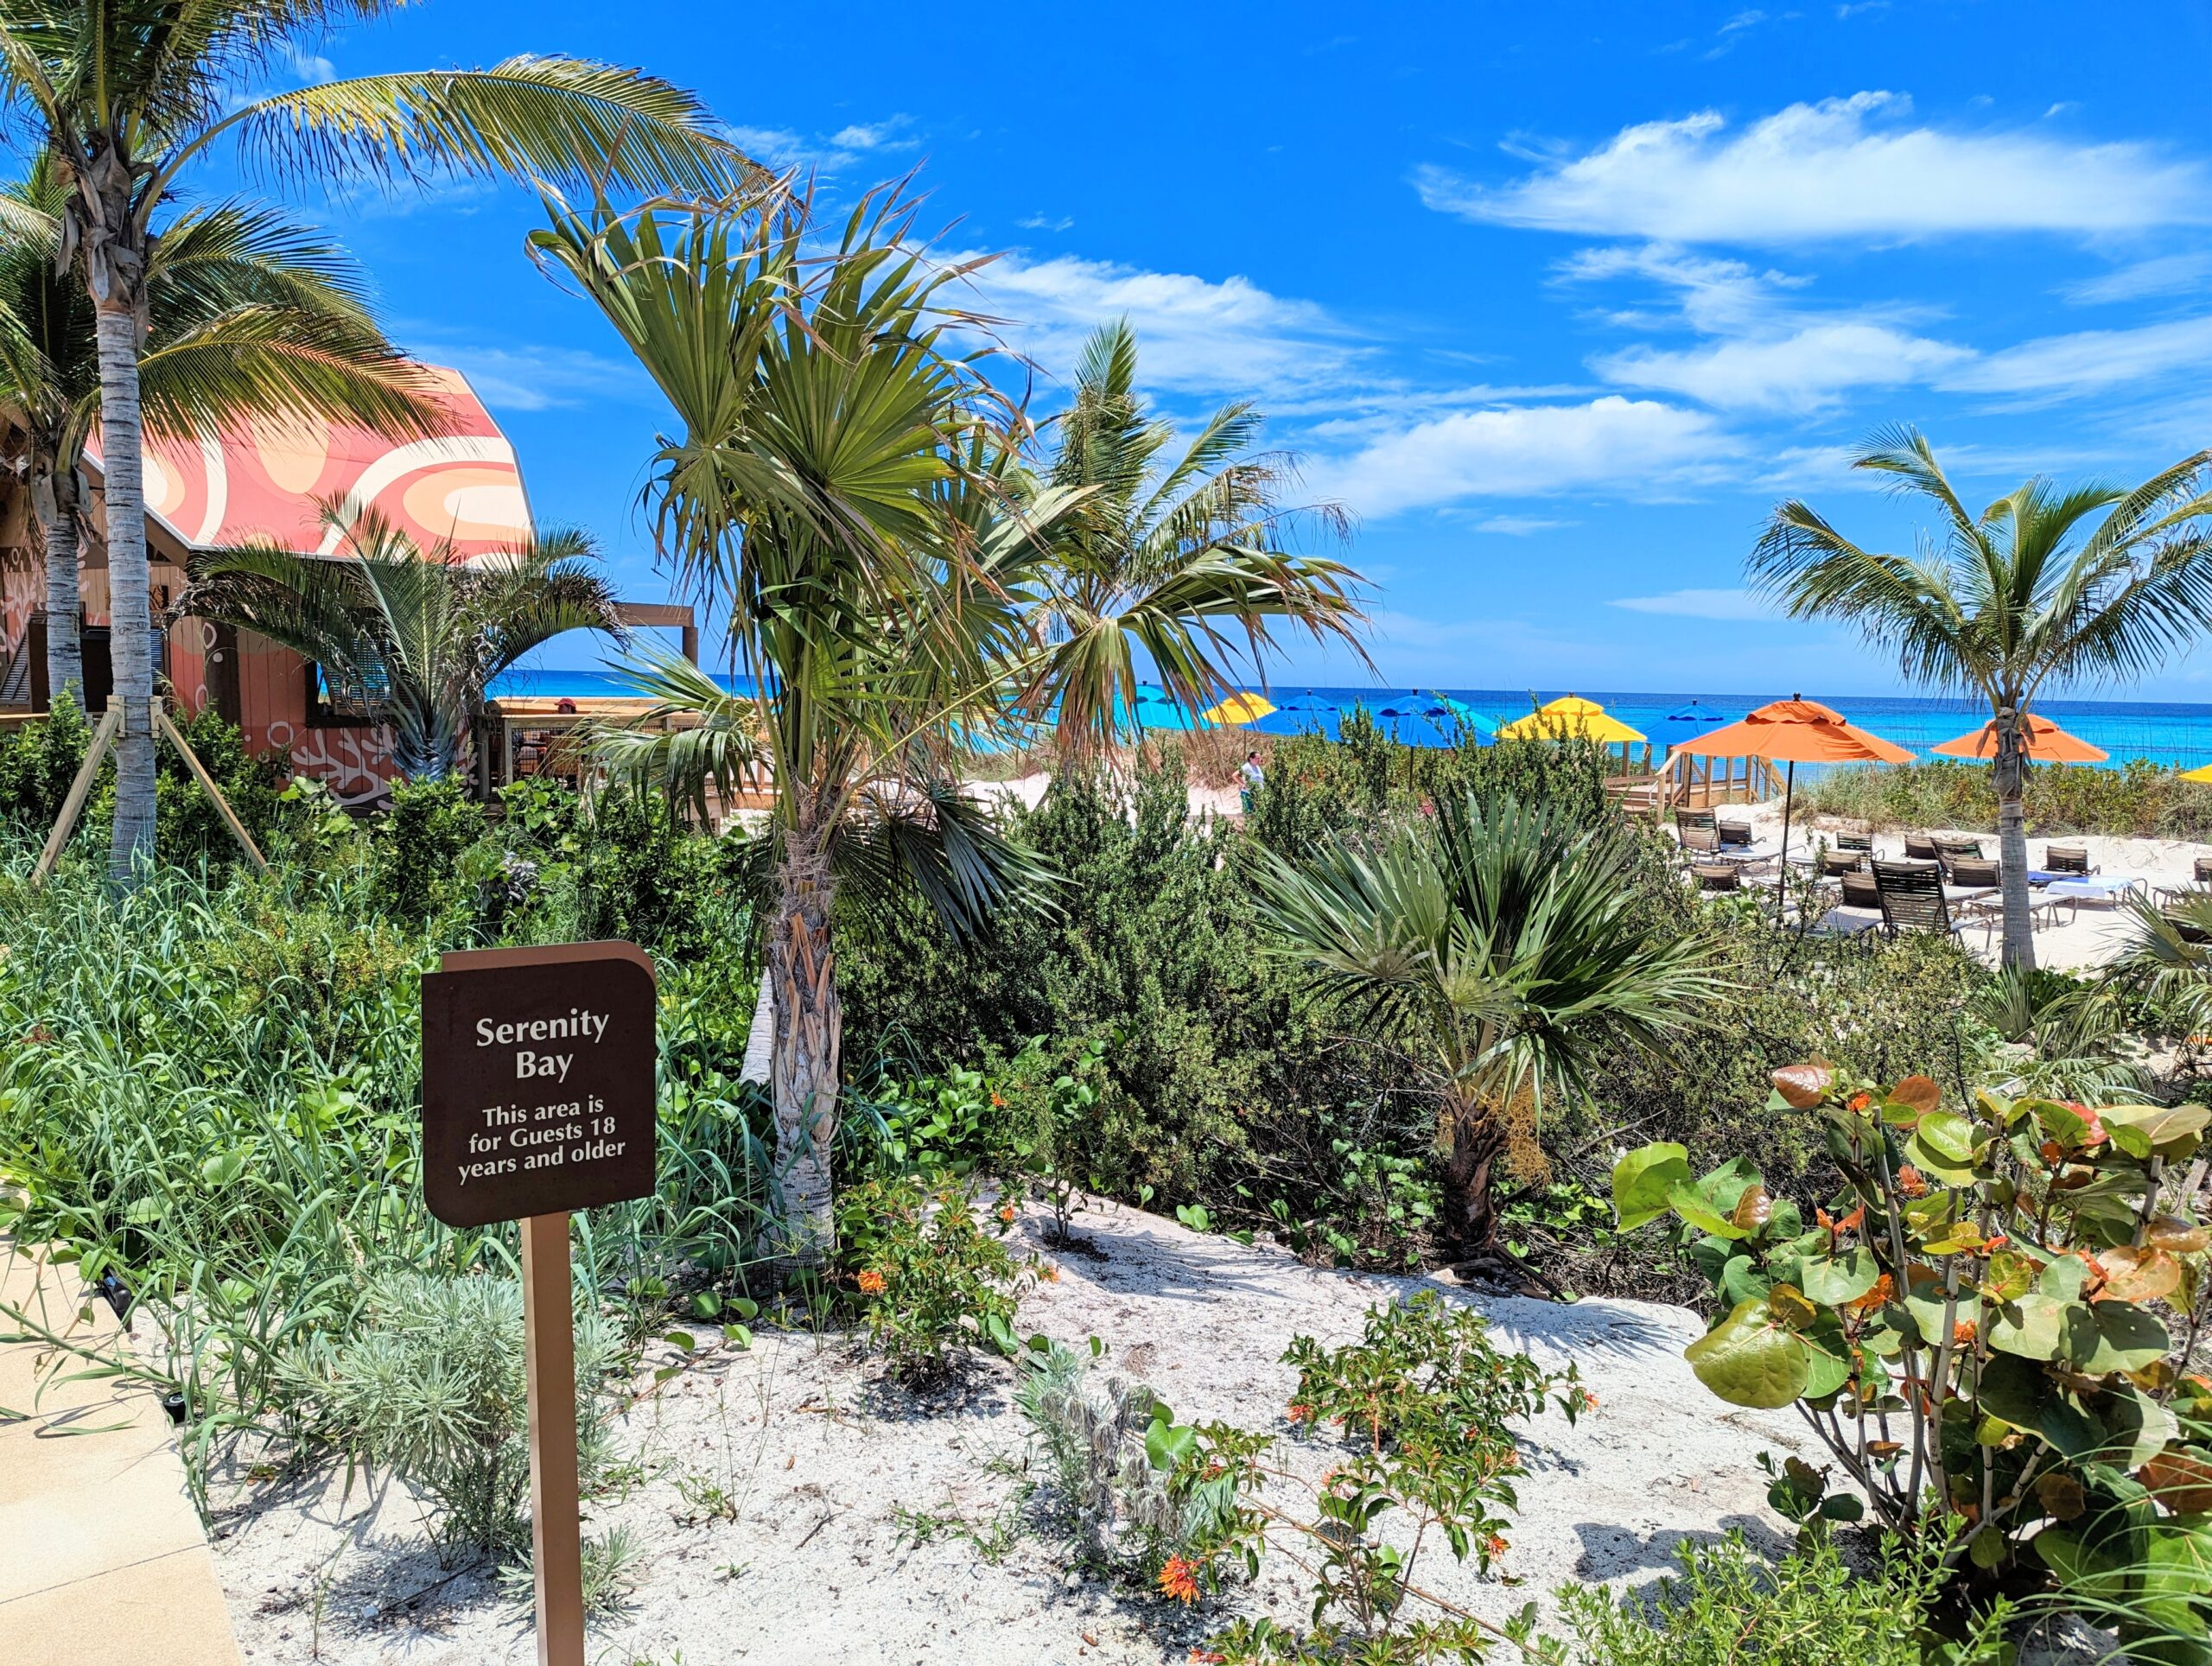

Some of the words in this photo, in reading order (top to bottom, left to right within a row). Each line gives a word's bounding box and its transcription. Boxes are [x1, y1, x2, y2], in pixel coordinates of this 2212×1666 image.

[476, 1008, 609, 1046] Serenity
[517, 1051, 574, 1084] Bay
[482, 1103, 527, 1127] This
[534, 1102, 581, 1121] area
[588, 1094, 604, 1113] is
[468, 1133, 502, 1154] for
[510, 1122, 582, 1148] Guests
[590, 1116, 616, 1136] 18
[458, 1158, 517, 1186] years
[524, 1145, 563, 1170] and
[571, 1139, 626, 1162] older
